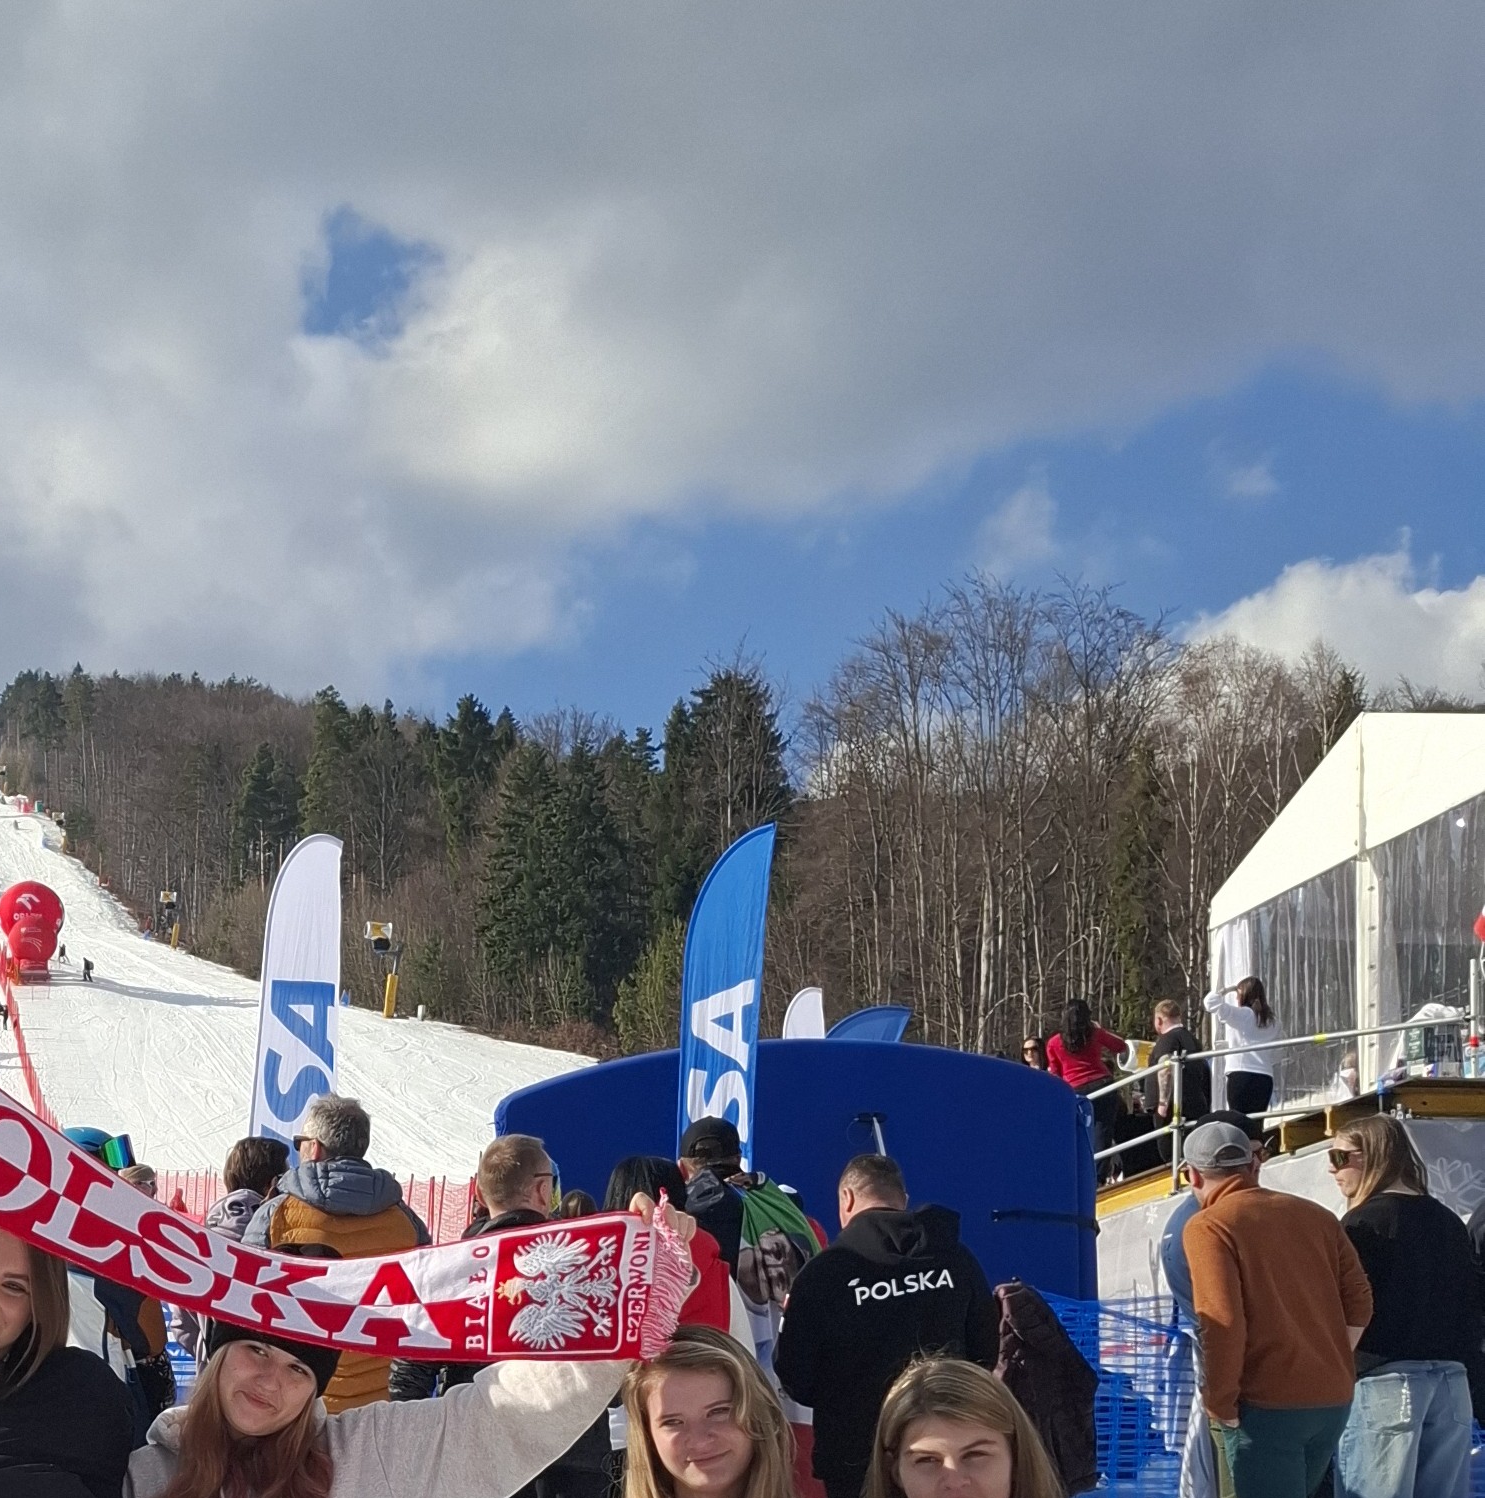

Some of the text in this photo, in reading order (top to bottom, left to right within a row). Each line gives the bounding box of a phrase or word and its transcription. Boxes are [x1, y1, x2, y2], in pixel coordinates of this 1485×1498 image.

[261, 980, 336, 1170] SA
[687, 979, 755, 1172] SA
[465, 1245, 490, 1350] BIAŁO
[625, 1231, 651, 1342] CZERWONI
[854, 1268, 955, 1306] POLSKA
